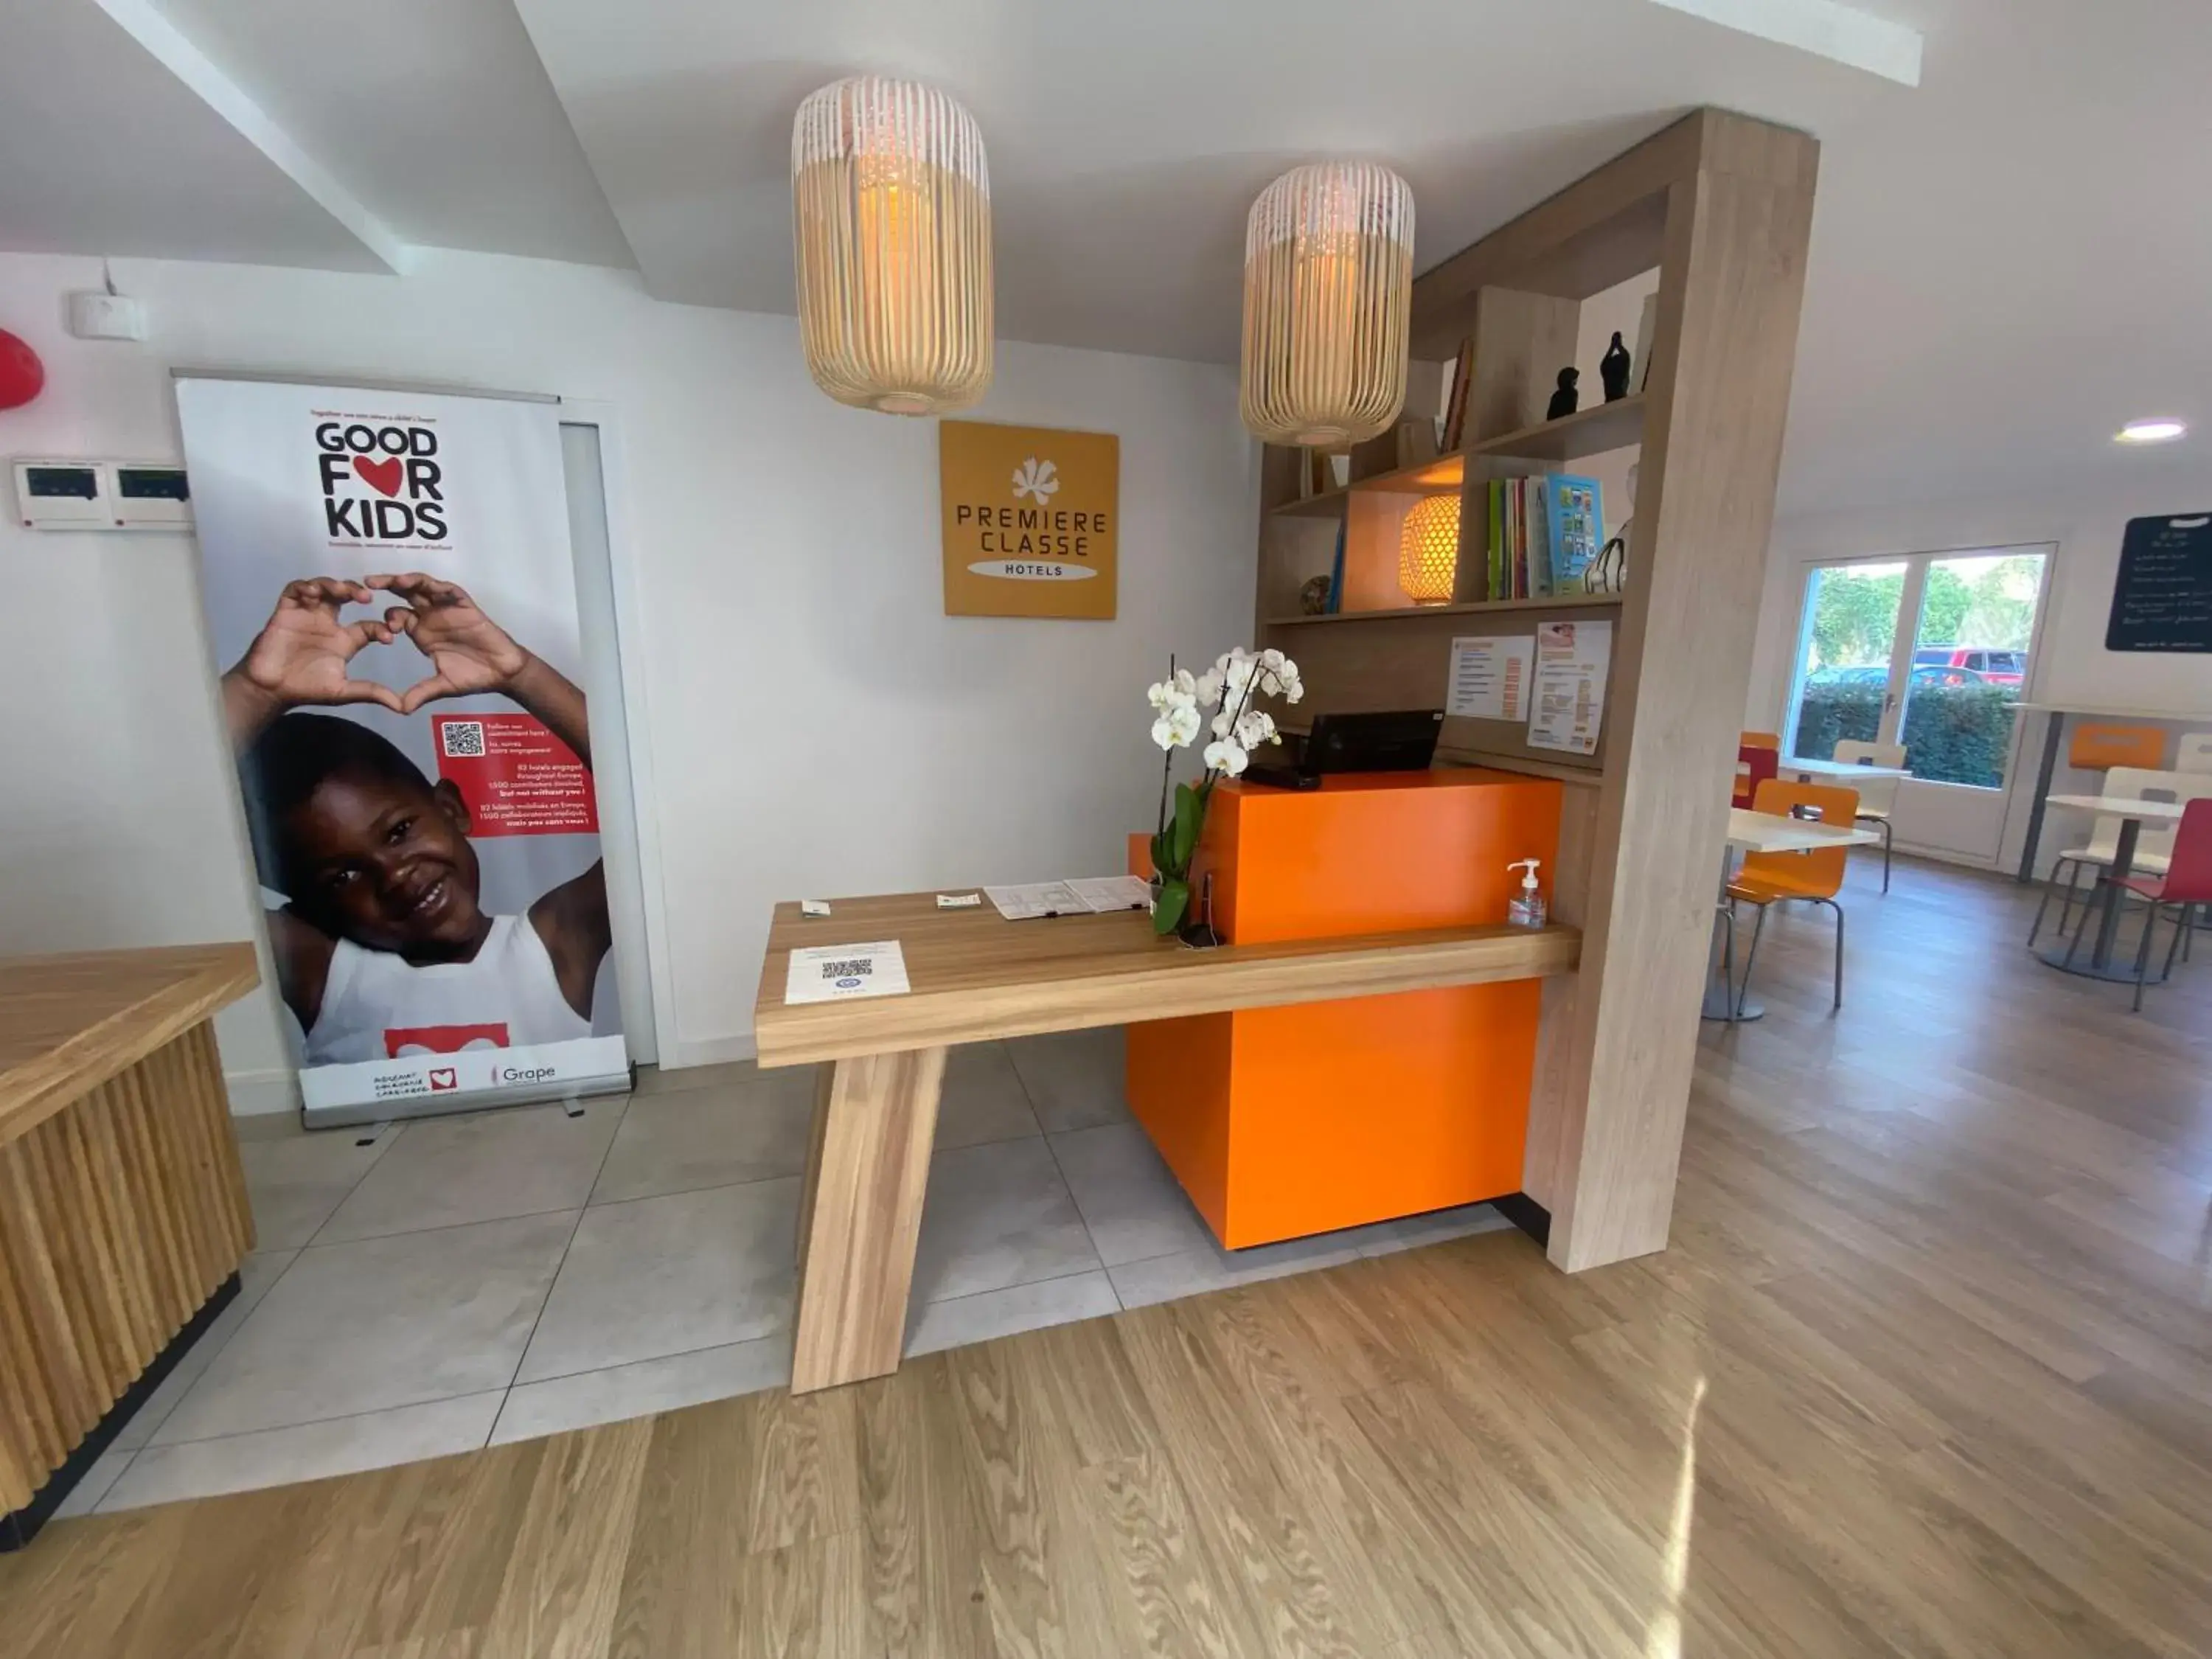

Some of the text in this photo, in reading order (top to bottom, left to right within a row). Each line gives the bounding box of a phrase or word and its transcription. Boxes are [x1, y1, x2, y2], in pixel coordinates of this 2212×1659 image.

[316, 422, 437, 456] GOOD
[324, 498, 448, 540] KIDS
[956, 504, 1106, 533] PREMIERE
[981, 532, 1088, 556] CLASSE
[1005, 564, 1062, 576] HOTELS
[504, 1067, 555, 1082] Grape
